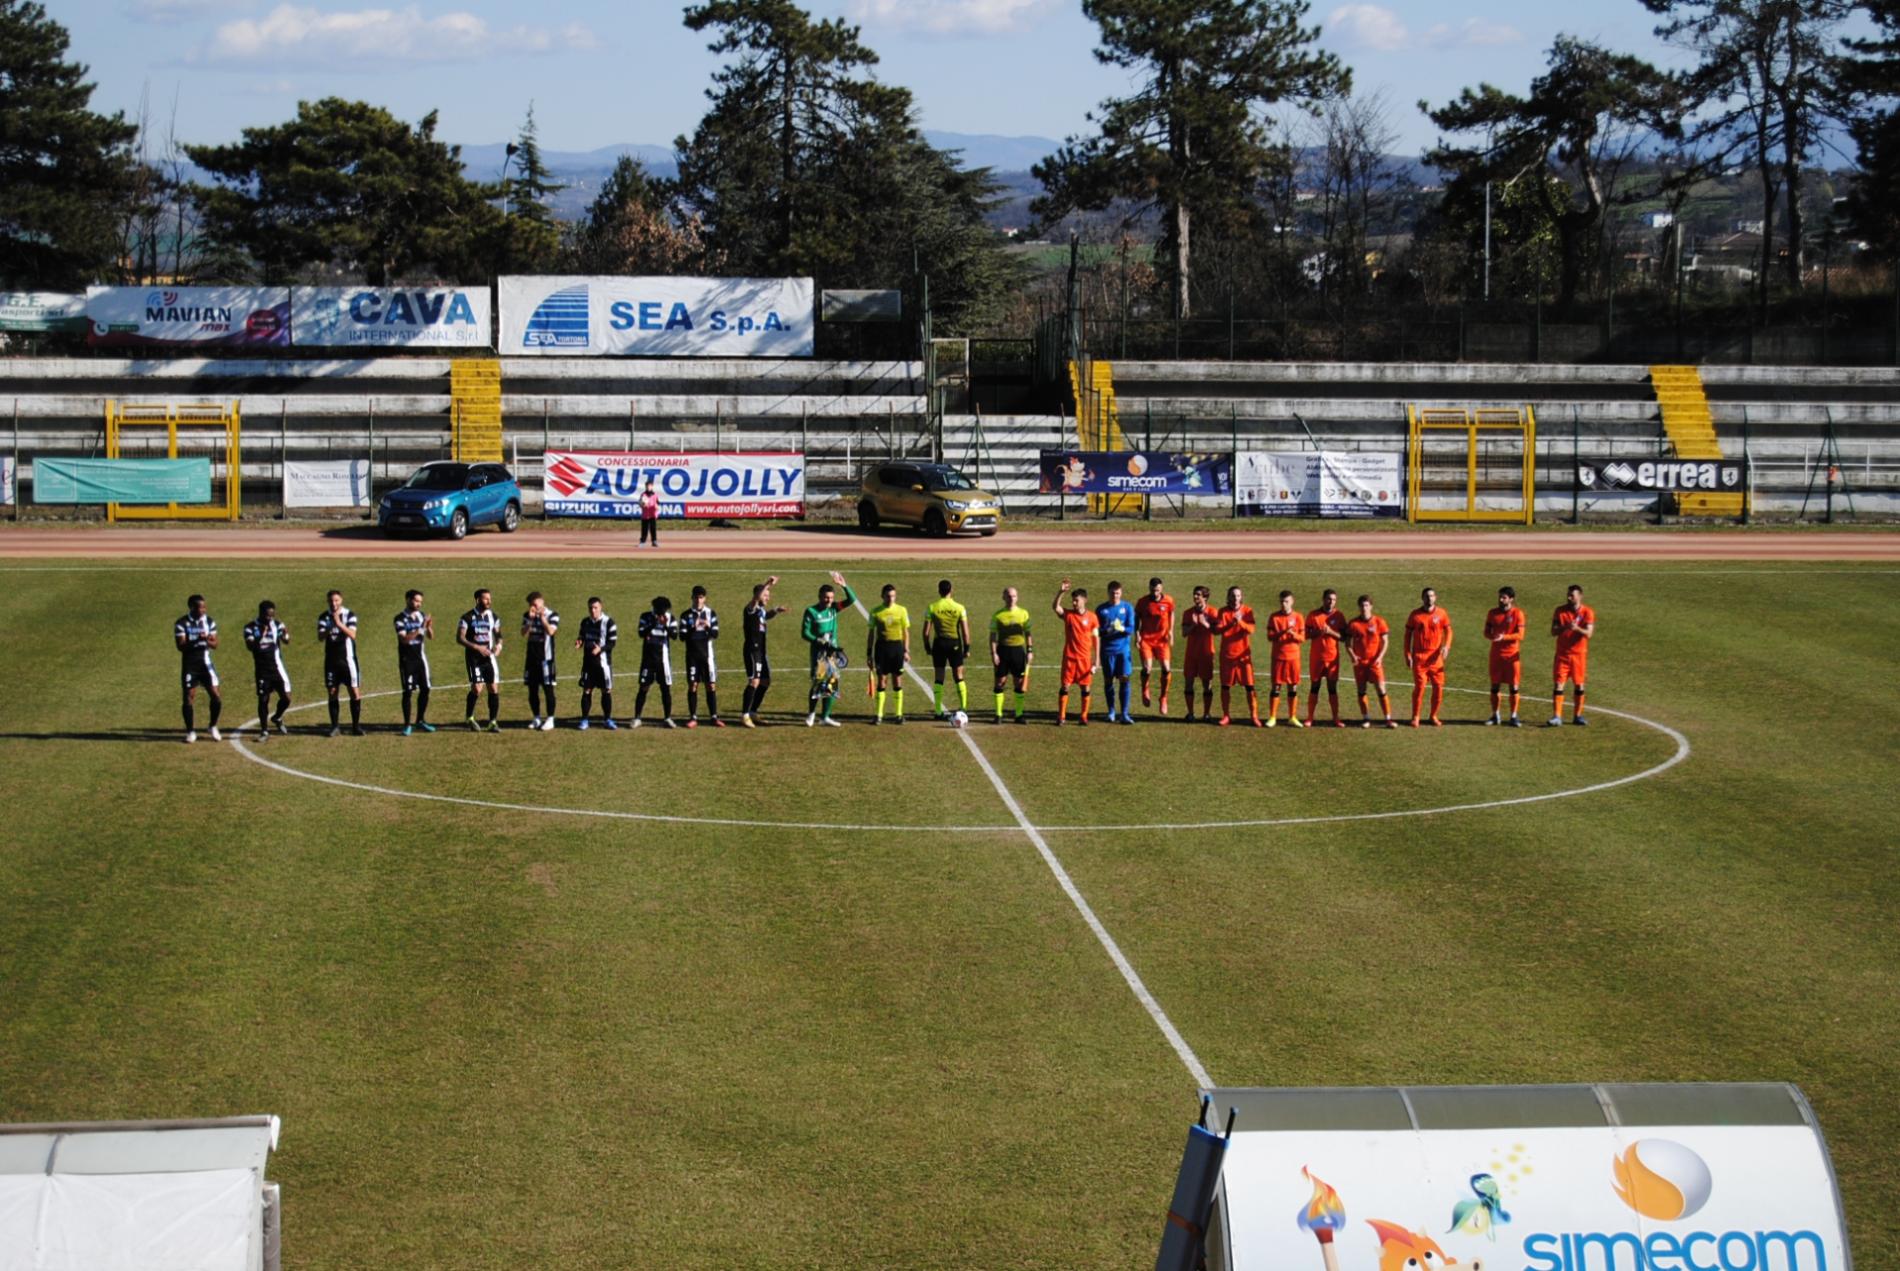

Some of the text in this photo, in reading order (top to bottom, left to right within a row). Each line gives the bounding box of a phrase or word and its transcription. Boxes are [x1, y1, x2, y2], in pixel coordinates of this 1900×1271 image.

[146, 308, 231, 321] MAVIAN
[350, 293, 477, 325] CAVA
[609, 302, 791, 336] SEA S.p.A.
[201, 323, 230, 331] max
[351, 331, 450, 340] INTERNATIONAL
[597, 458, 689, 466] CONCESSIONARIA
[586, 468, 802, 497] AUTOJOLLY
[1107, 476, 1168, 487] simecom
[545, 502, 600, 514] SUZUKI
[613, 503, 683, 515] TORNA
[1523, 1230, 1827, 1271] simecom
